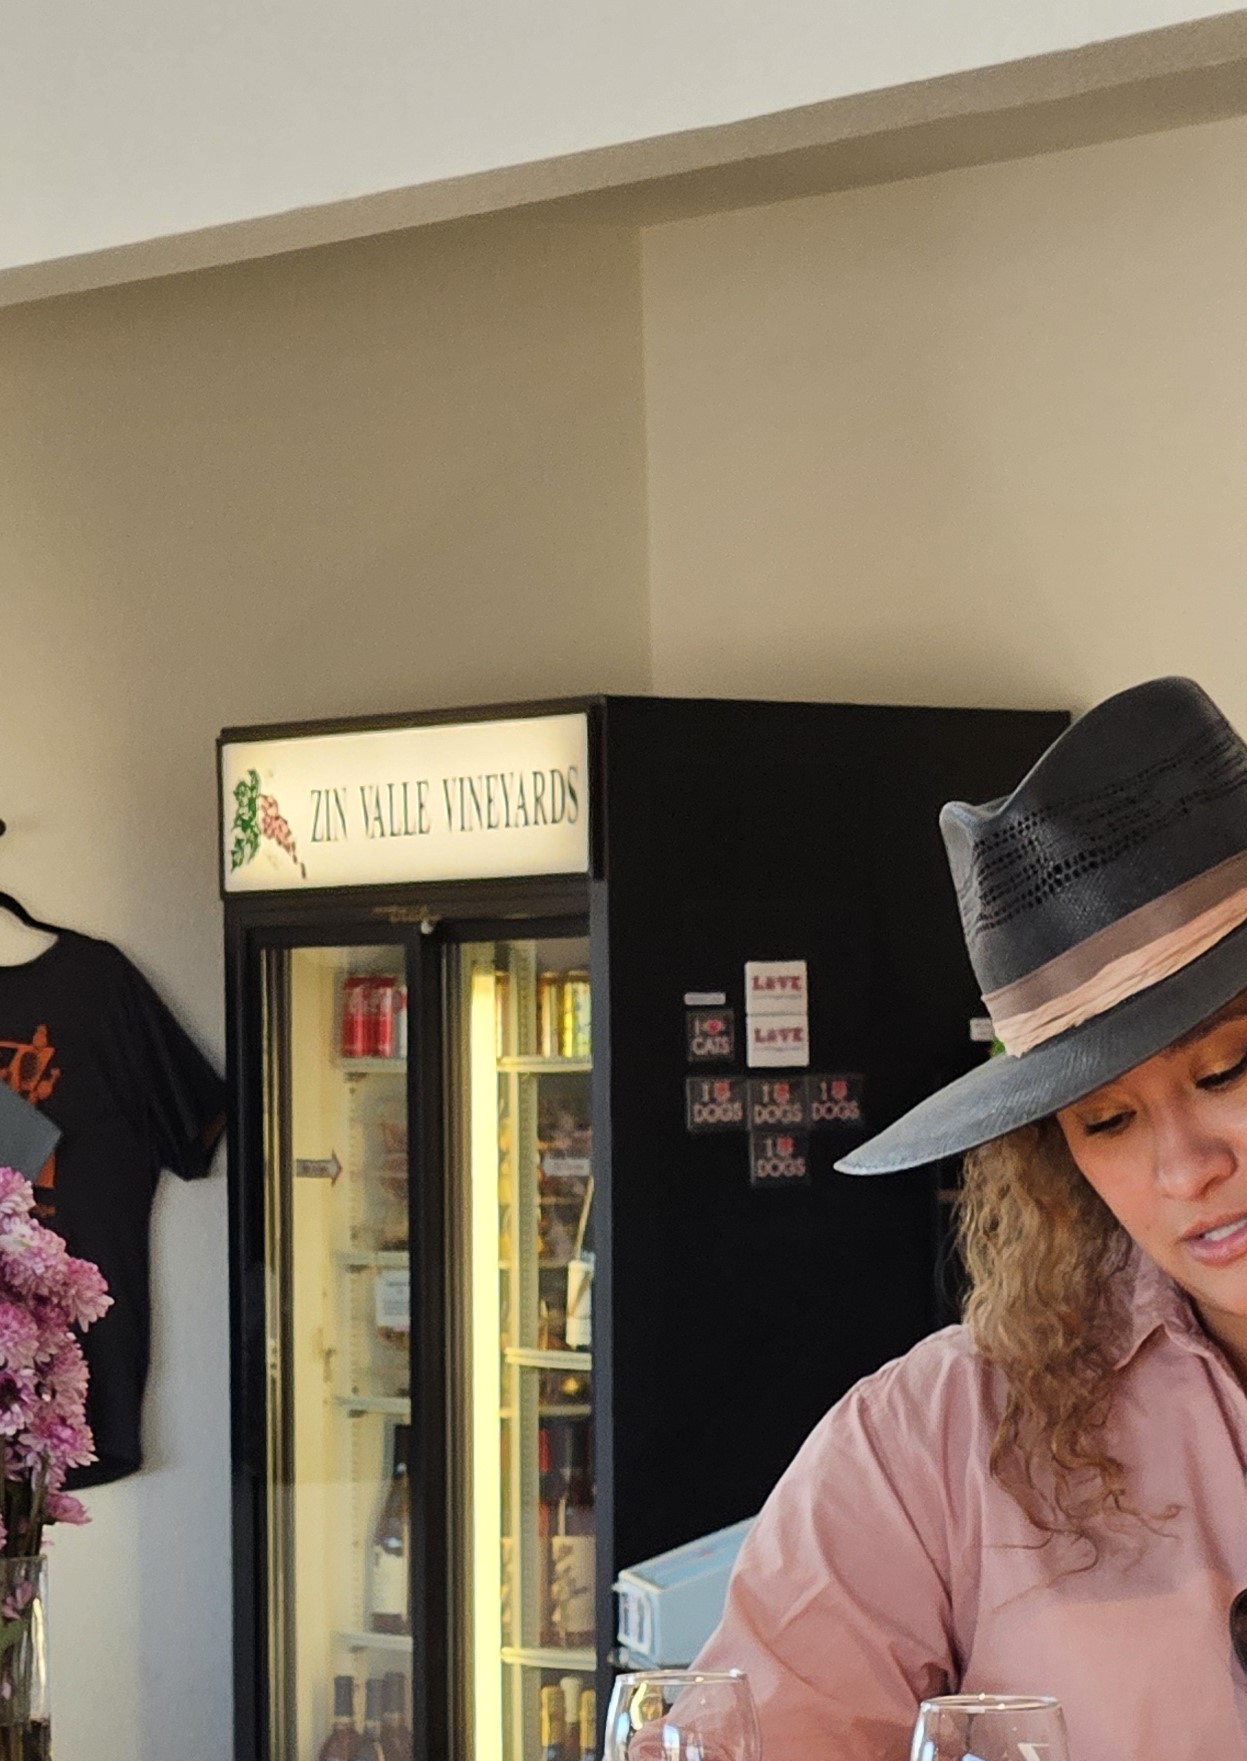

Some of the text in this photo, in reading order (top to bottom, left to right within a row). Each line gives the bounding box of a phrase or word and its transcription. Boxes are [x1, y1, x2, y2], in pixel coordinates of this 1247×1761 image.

[310, 764, 579, 843] ZIN VALLE VINEYARDS
[692, 1036, 732, 1056] CATS
[694, 1102, 743, 1123] DOGS
[754, 1103, 802, 1124] DOGS
[812, 1100, 860, 1120] DOGS
[758, 1157, 806, 1177] DOGS
